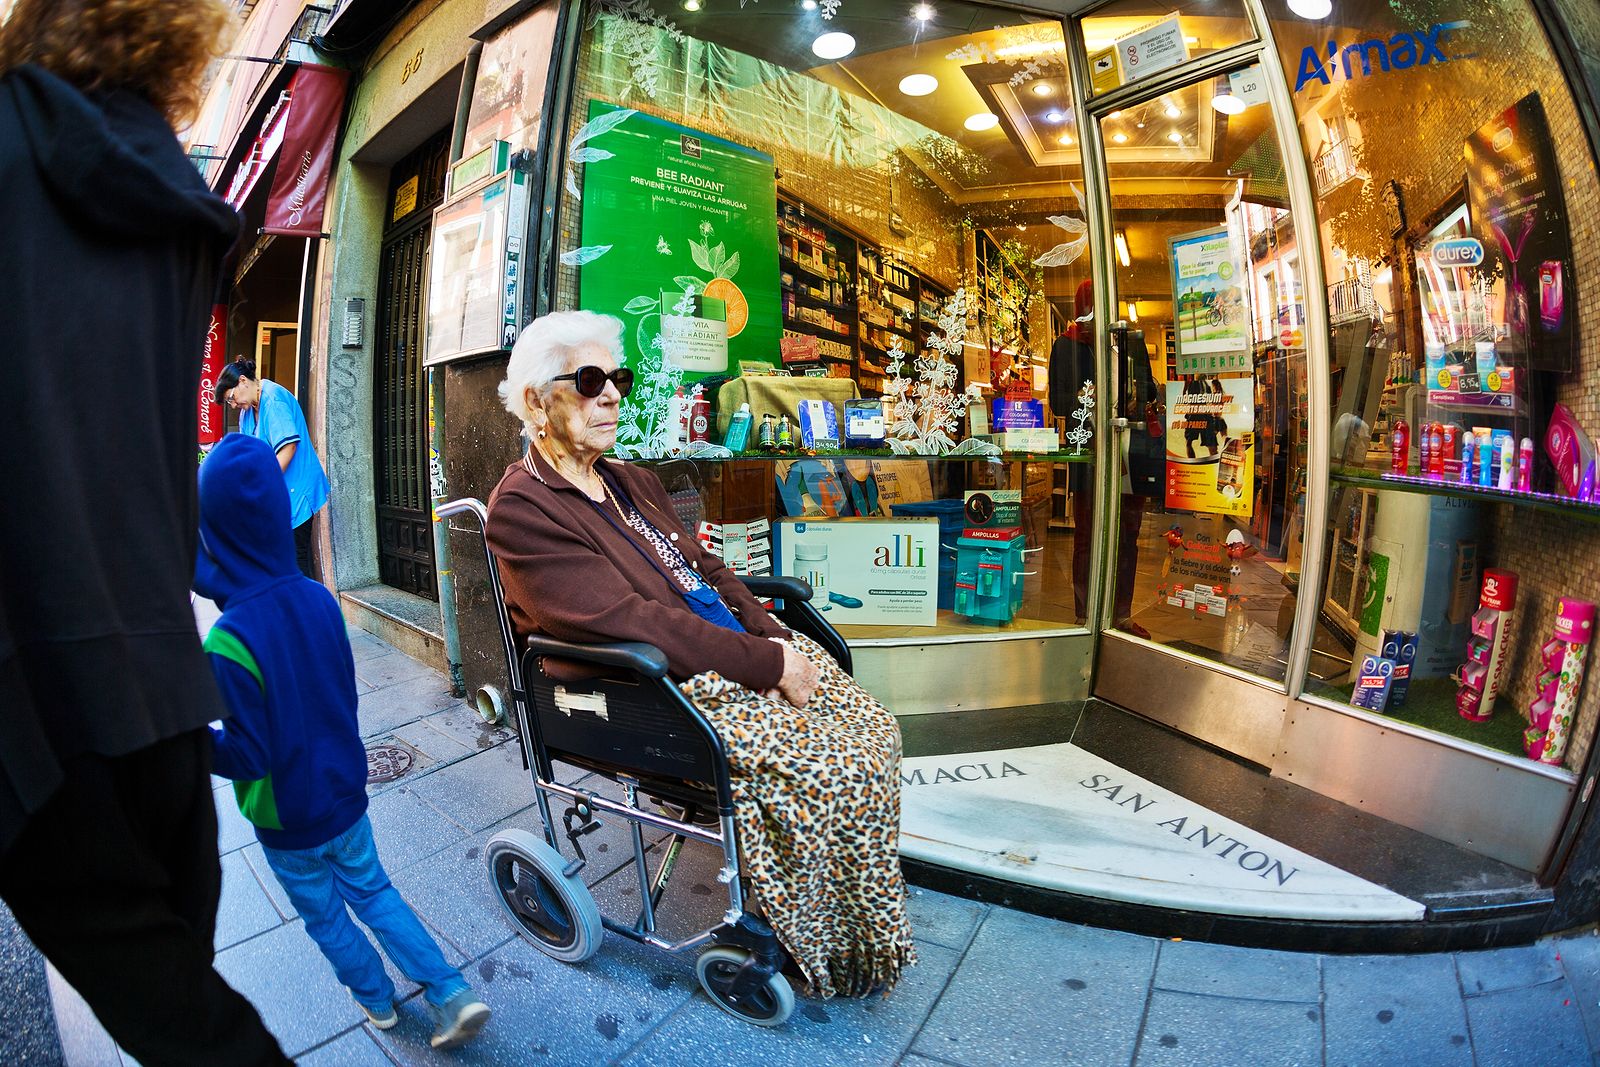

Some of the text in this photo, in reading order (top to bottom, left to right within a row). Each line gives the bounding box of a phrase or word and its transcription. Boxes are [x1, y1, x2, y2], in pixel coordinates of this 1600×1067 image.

[401, 48, 424, 84] 66
[1295, 23, 1455, 93] Almax
[1242, 82, 1256, 93] L20
[656, 167, 724, 193] BEE RADIANT
[630, 176, 664, 190] PREVIENE
[674, 186, 702, 199] SUAVIZA
[703, 193, 716, 202] LAS
[717, 196, 748, 210] ARRUGAS
[679, 200, 697, 209] JOVEN
[1437, 244, 1479, 260] durex
[1183, 354, 1245, 370] ABIERTO
[873, 462, 881, 471] NO
[876, 472, 897, 483] ESTROPEE
[1078, 774, 1300, 886] SAN ANTON
